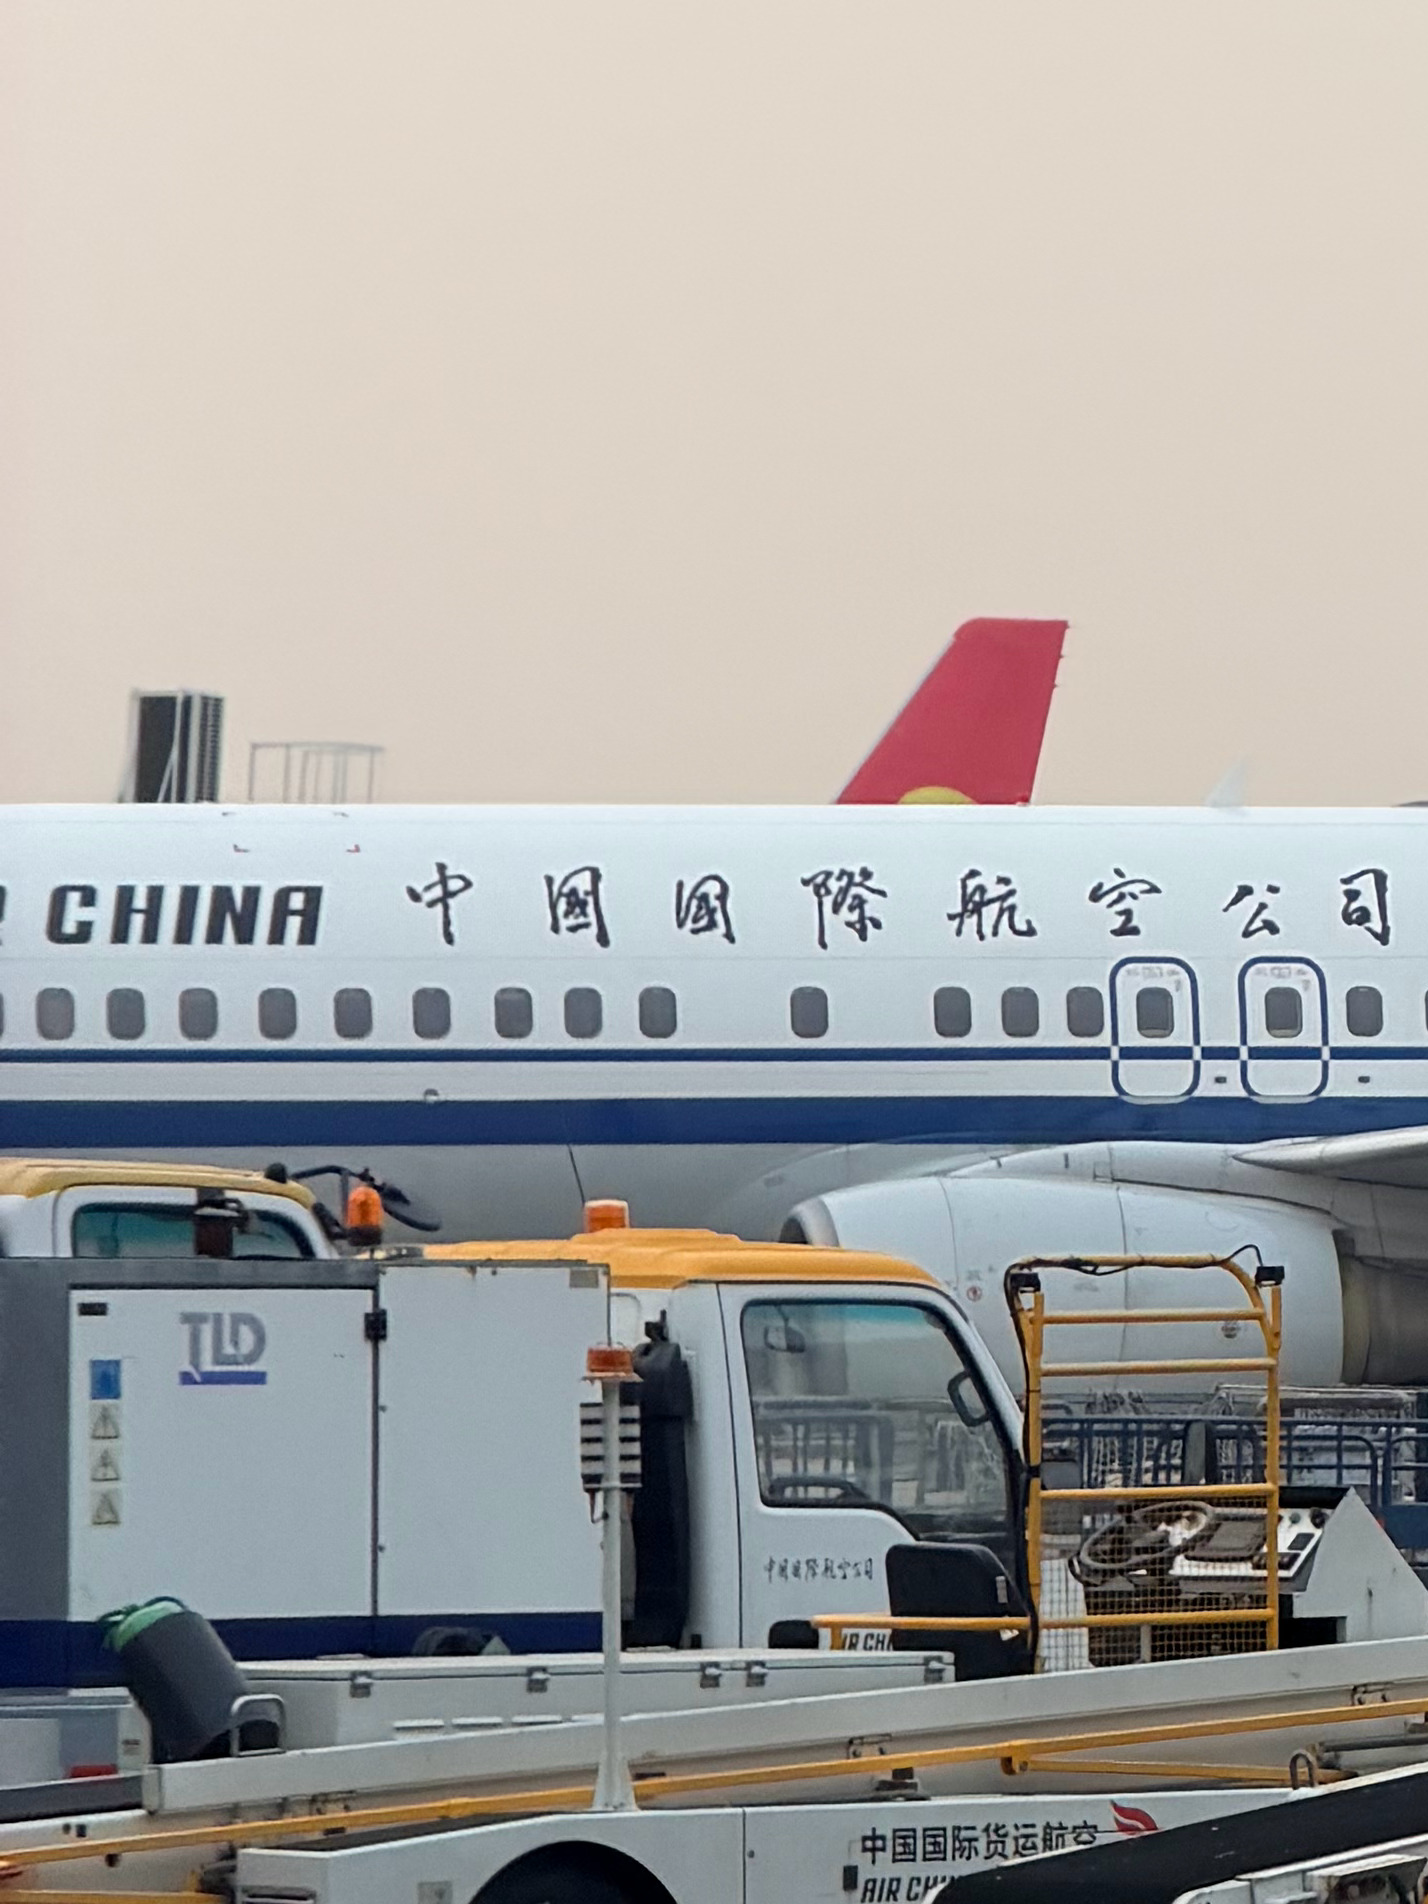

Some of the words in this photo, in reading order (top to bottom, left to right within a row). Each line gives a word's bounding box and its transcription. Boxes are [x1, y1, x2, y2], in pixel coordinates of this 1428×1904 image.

[46, 884, 323, 946] CHINA
[179, 1311, 266, 1374] TLD
[860, 1877, 902, 1904] AIR
